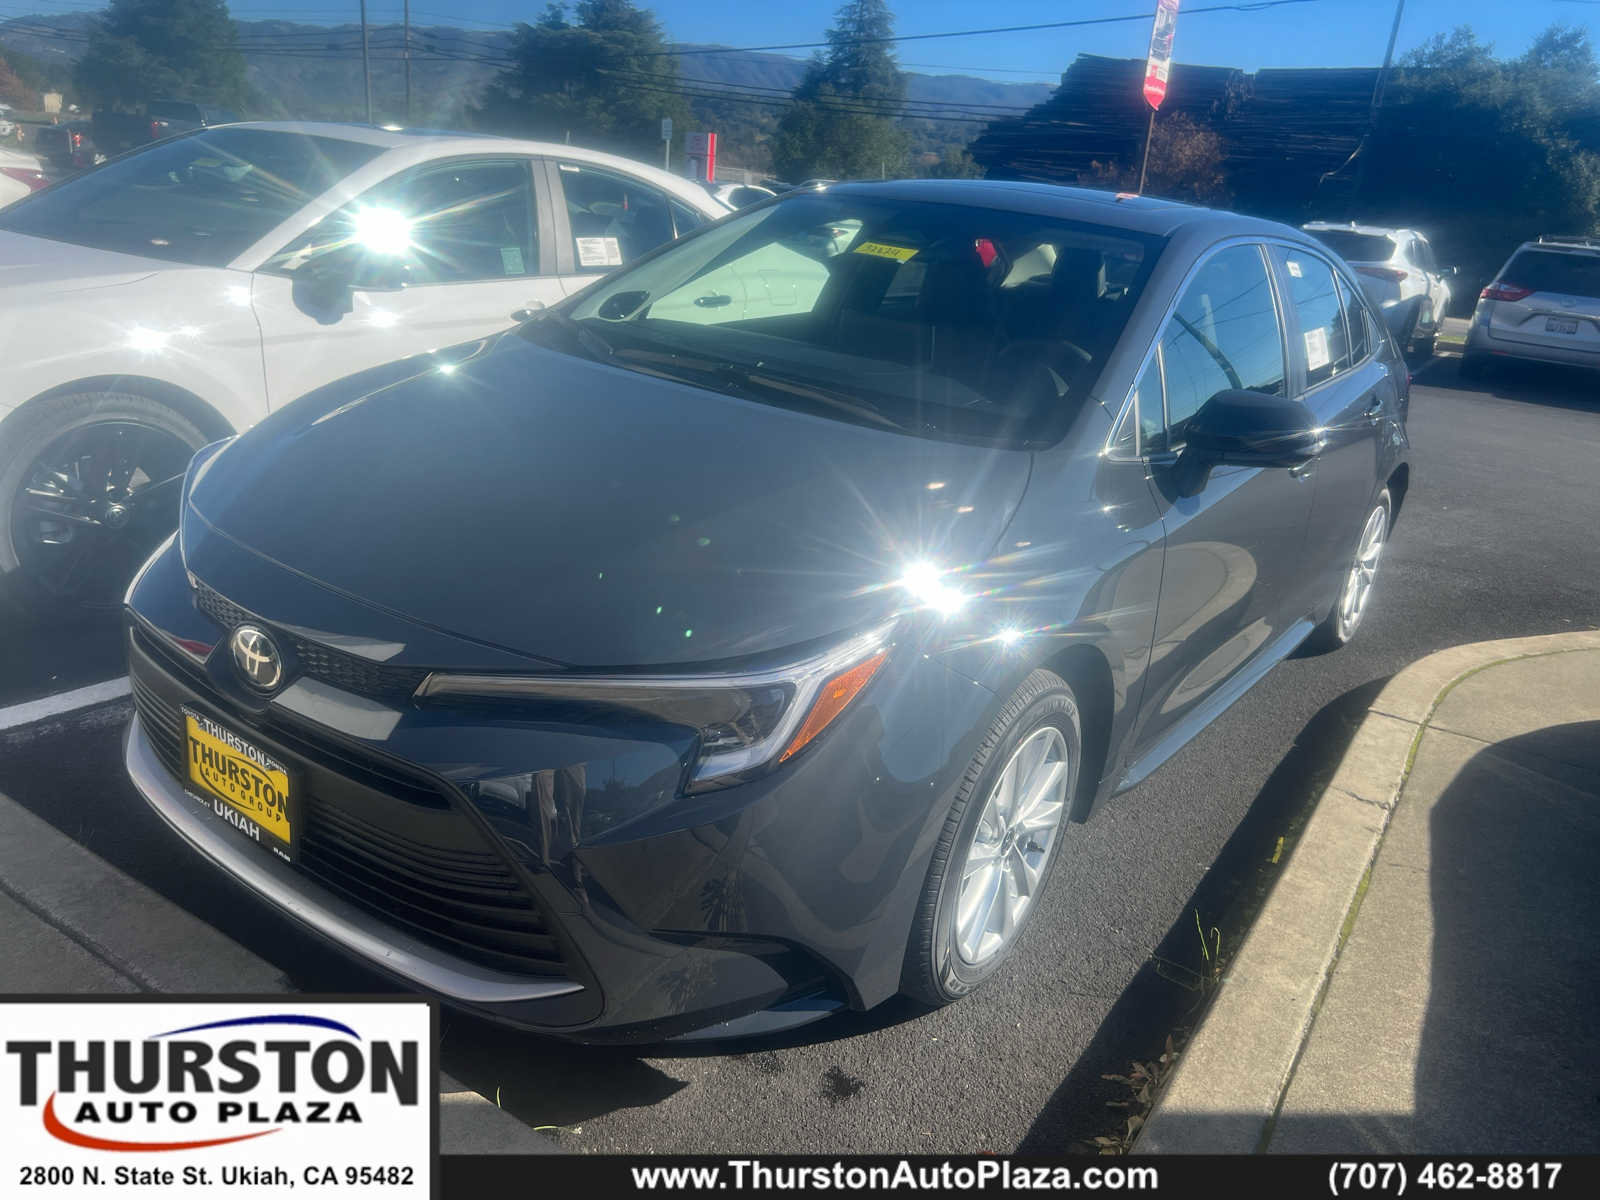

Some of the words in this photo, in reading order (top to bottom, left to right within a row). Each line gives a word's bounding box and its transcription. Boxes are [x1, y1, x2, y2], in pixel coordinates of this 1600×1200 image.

[203, 717, 265, 766] THURSTON
[189, 736, 291, 823] THURSTON
[204, 767, 235, 793] AUTO
[240, 789, 281, 823] GROUP
[213, 799, 260, 841] UKIAH
